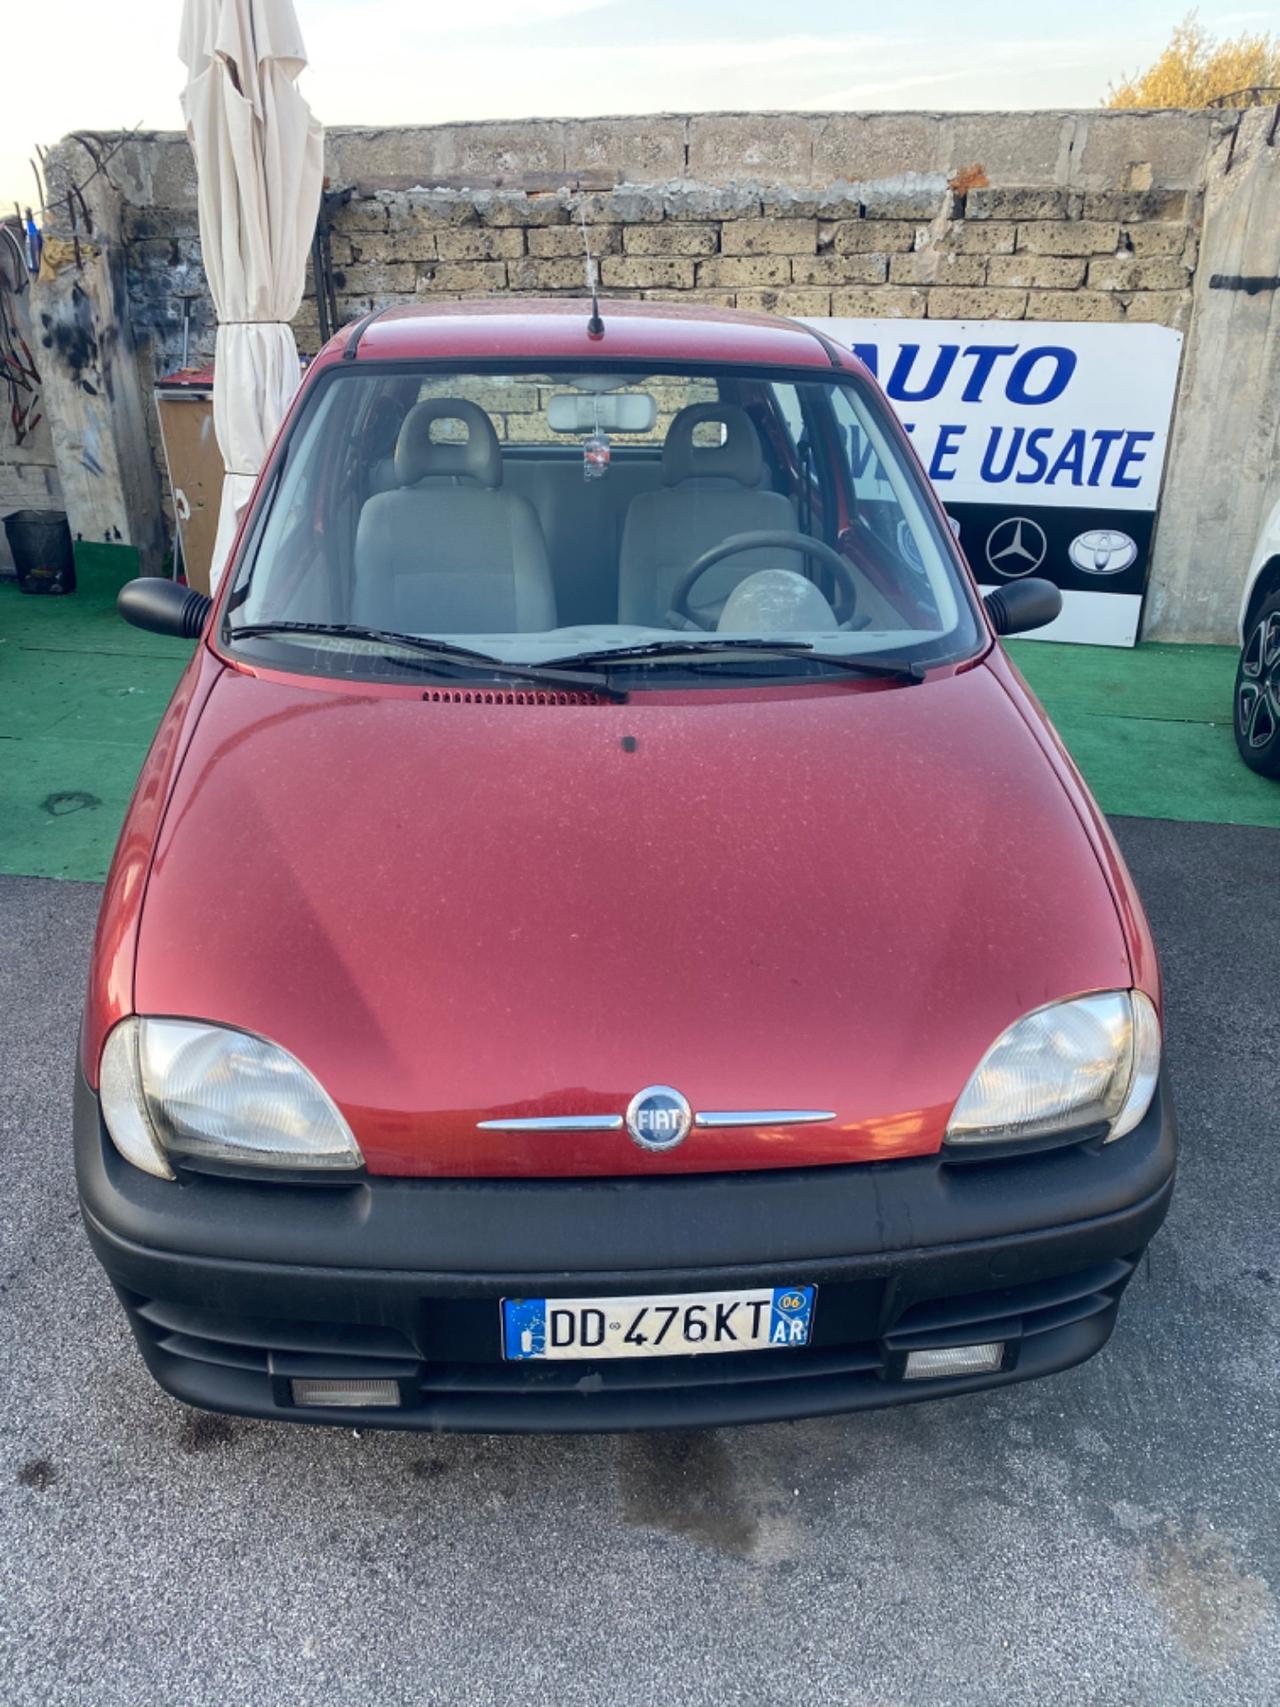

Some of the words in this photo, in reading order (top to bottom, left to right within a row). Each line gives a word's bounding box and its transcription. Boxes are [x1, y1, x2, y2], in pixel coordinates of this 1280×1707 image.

[929, 425, 967, 480] E
[980, 427, 1154, 488] USATE
[638, 1109, 680, 1130] FIAT
[783, 1296, 799, 1308] 06
[550, 1309, 605, 1347] DD
[773, 1320, 802, 1342] AR
